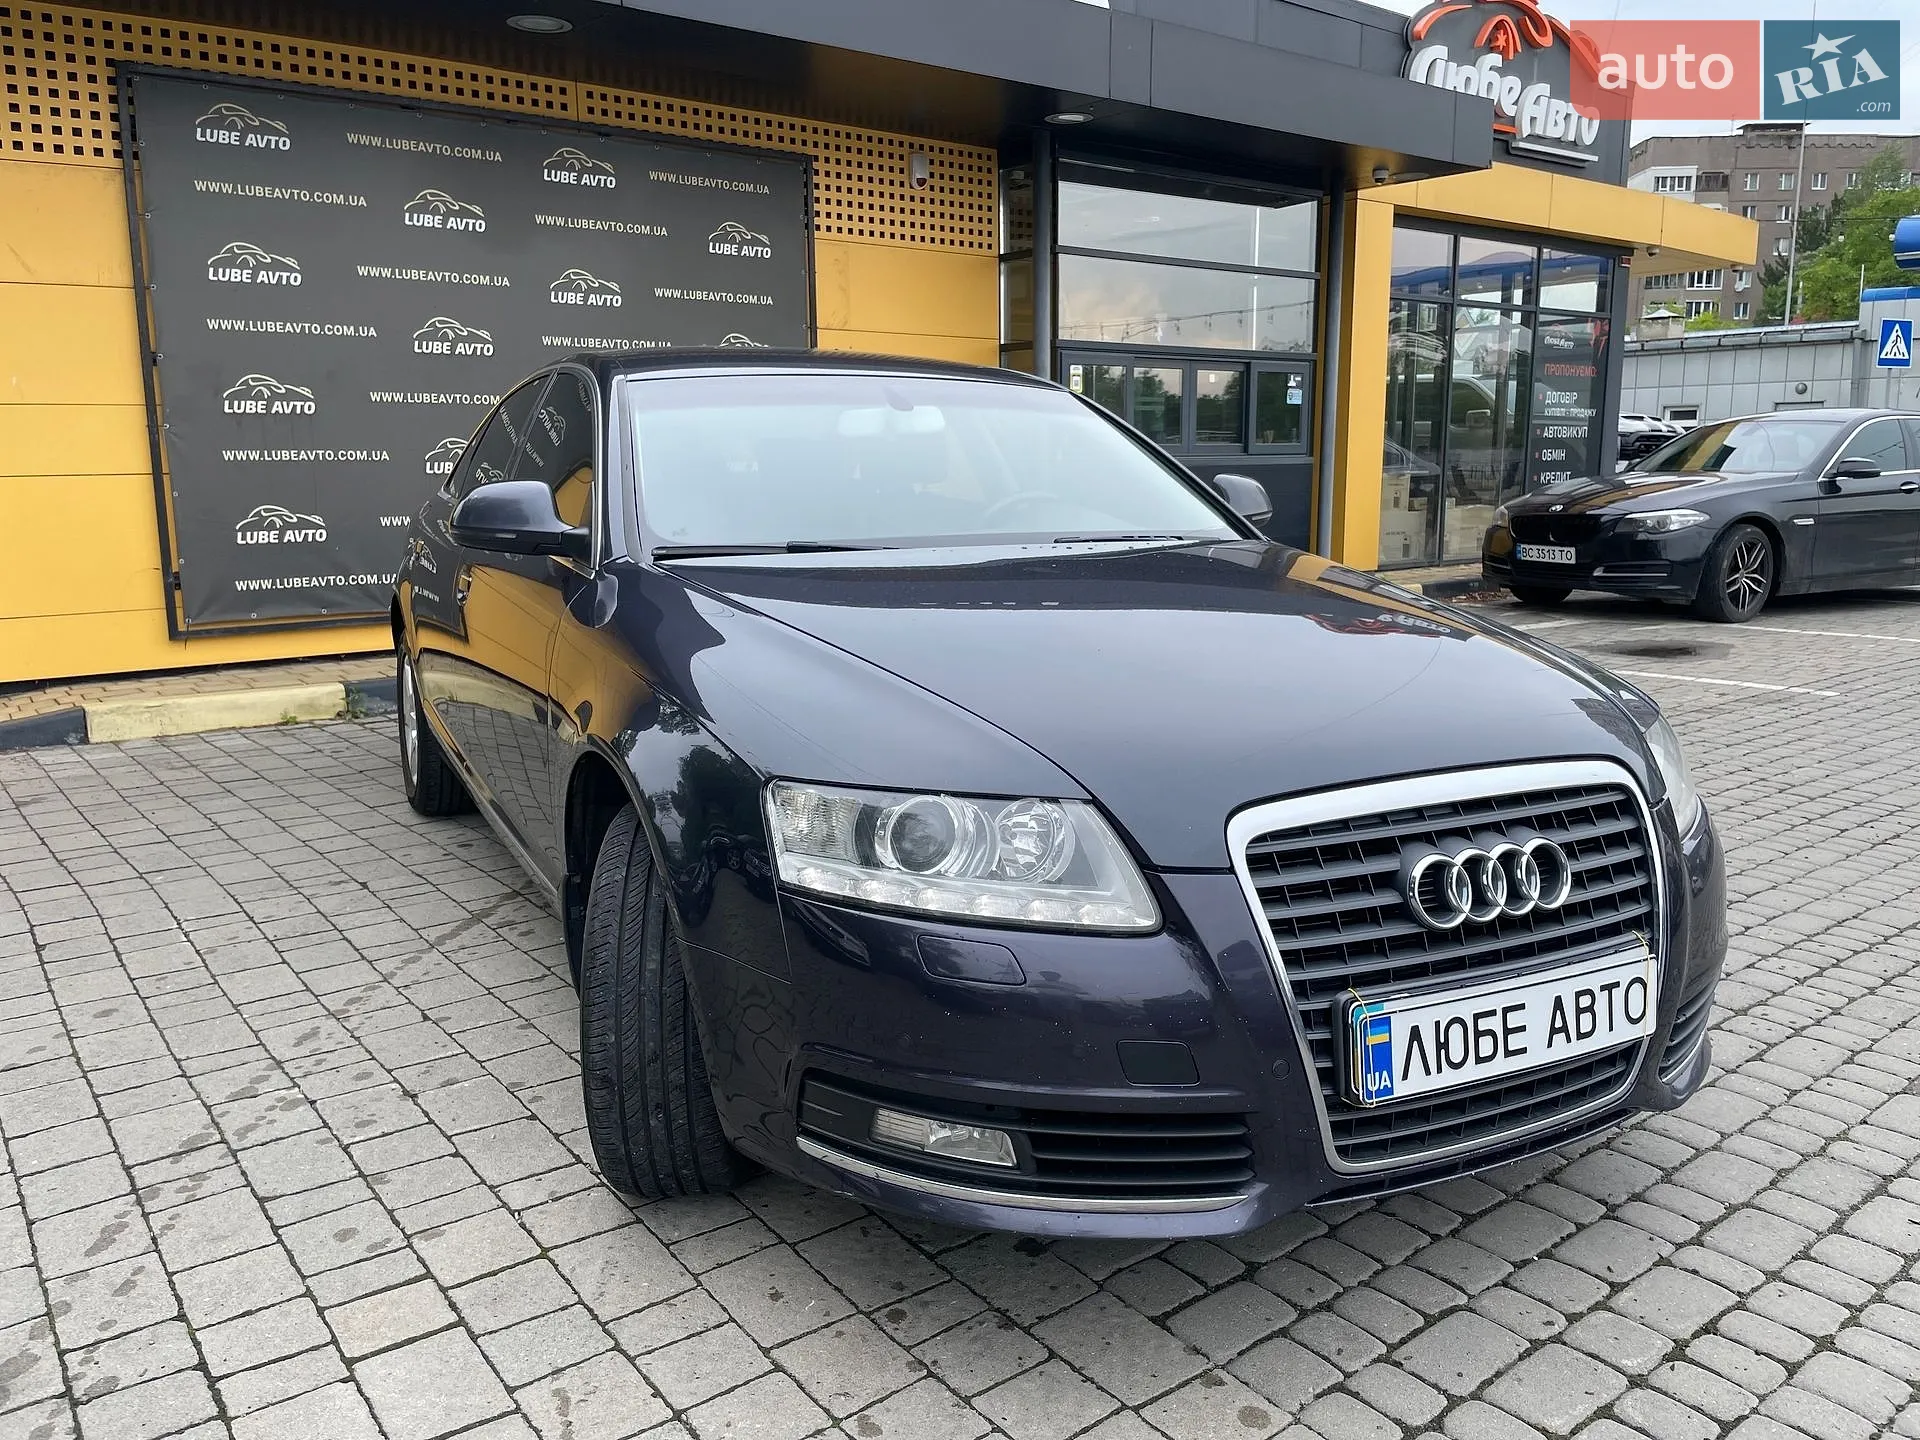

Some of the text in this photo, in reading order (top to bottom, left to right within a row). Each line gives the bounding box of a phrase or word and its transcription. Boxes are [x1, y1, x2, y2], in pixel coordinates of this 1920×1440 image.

[197, 128, 290, 150] LUBE AVTO
[347, 133, 502, 161] WWW.LUBEAVTO.COM.UA
[544, 169, 615, 188] LUBE AVTO
[649, 171, 769, 194] WWW.LUBEAVTO.COM.UA
[194, 180, 366, 207] WWW.LUBEAVTO.COM.UA
[405, 212, 485, 232] LUBE AVTO
[535, 215, 667, 236] WWW.LUBEAVTO.COM.UA
[709, 242, 771, 258] LUBE AVTO
[209, 268, 301, 285] LUBE AVTO
[357, 266, 509, 286] WWW.LUBEAVTO.COM.UA
[551, 290, 621, 306] LUBE AVTO
[655, 288, 773, 304] WWW.LUBEAVTO.COM.UA
[207, 319, 377, 337] WWW.LUBEAVTO.COM.UA
[415, 341, 493, 355] LUBE AVTO
[1545, 391, 1578, 405] ДОГОВІР
[225, 401, 315, 414] LUBE AVTO
[1543, 426, 1588, 438] АВТОВИКУП
[223, 450, 389, 460] WWW.LUBEAVTO.COM.UA
[1541, 449, 1566, 461] ОБМІН
[237, 530, 326, 543] LUBE AVTO
[1522, 547, 1573, 561] BC 3513 TO
[1401, 977, 1646, 1081] ЛЮБЕ АВТО
[1367, 1072, 1392, 1091] UA
